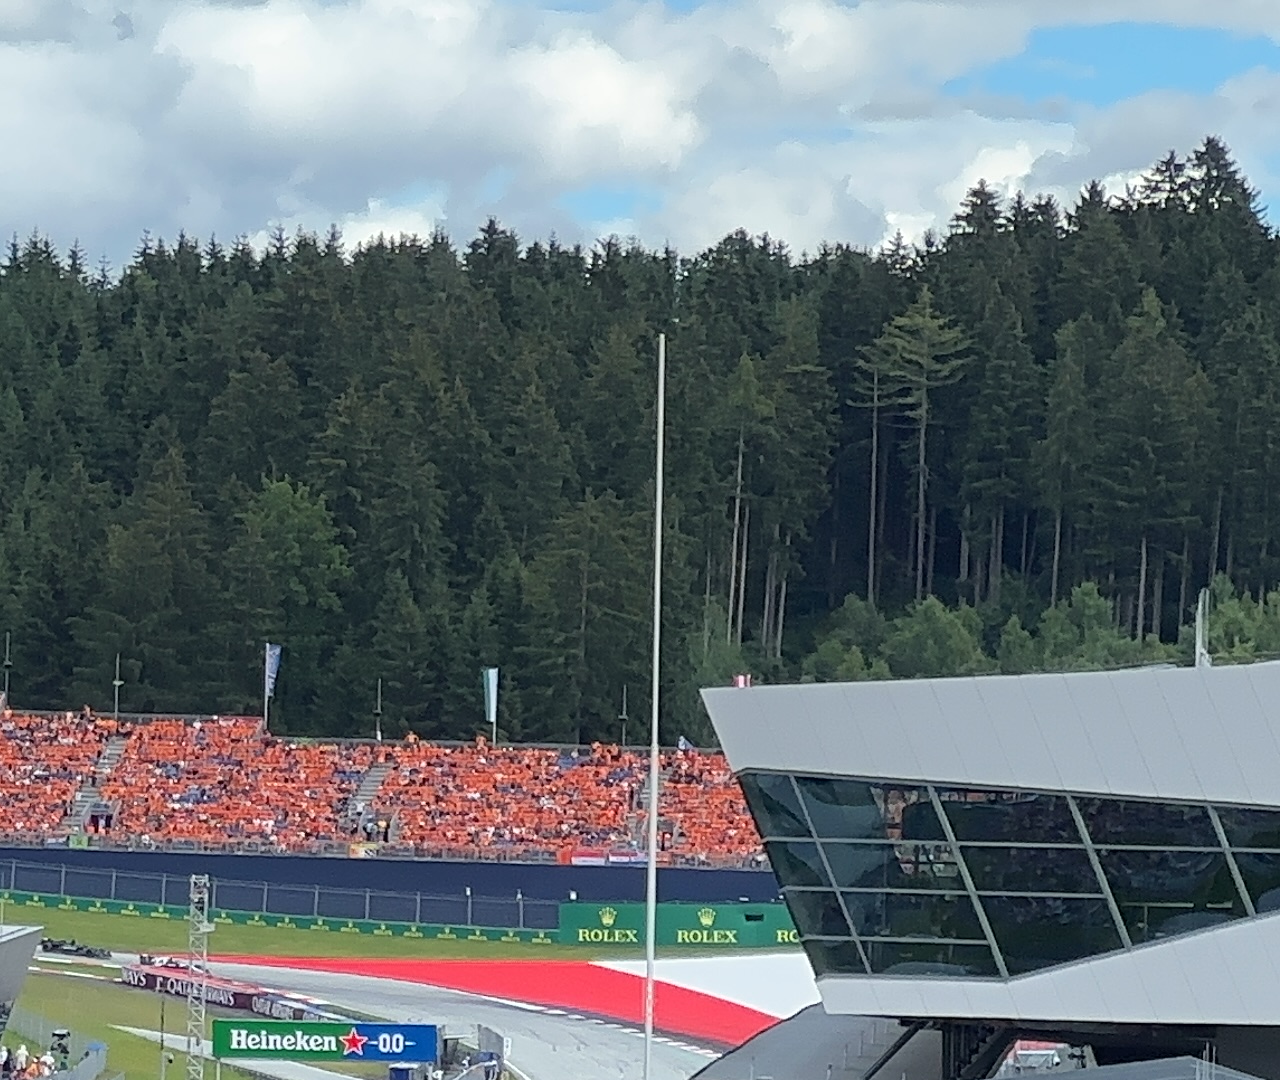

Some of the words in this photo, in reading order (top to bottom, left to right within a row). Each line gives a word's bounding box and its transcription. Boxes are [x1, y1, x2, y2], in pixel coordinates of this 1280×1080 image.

[578, 928, 638, 943] ROLEX
[677, 929, 737, 944] ROLEX
[229, 1028, 337, 1051] Heineken
